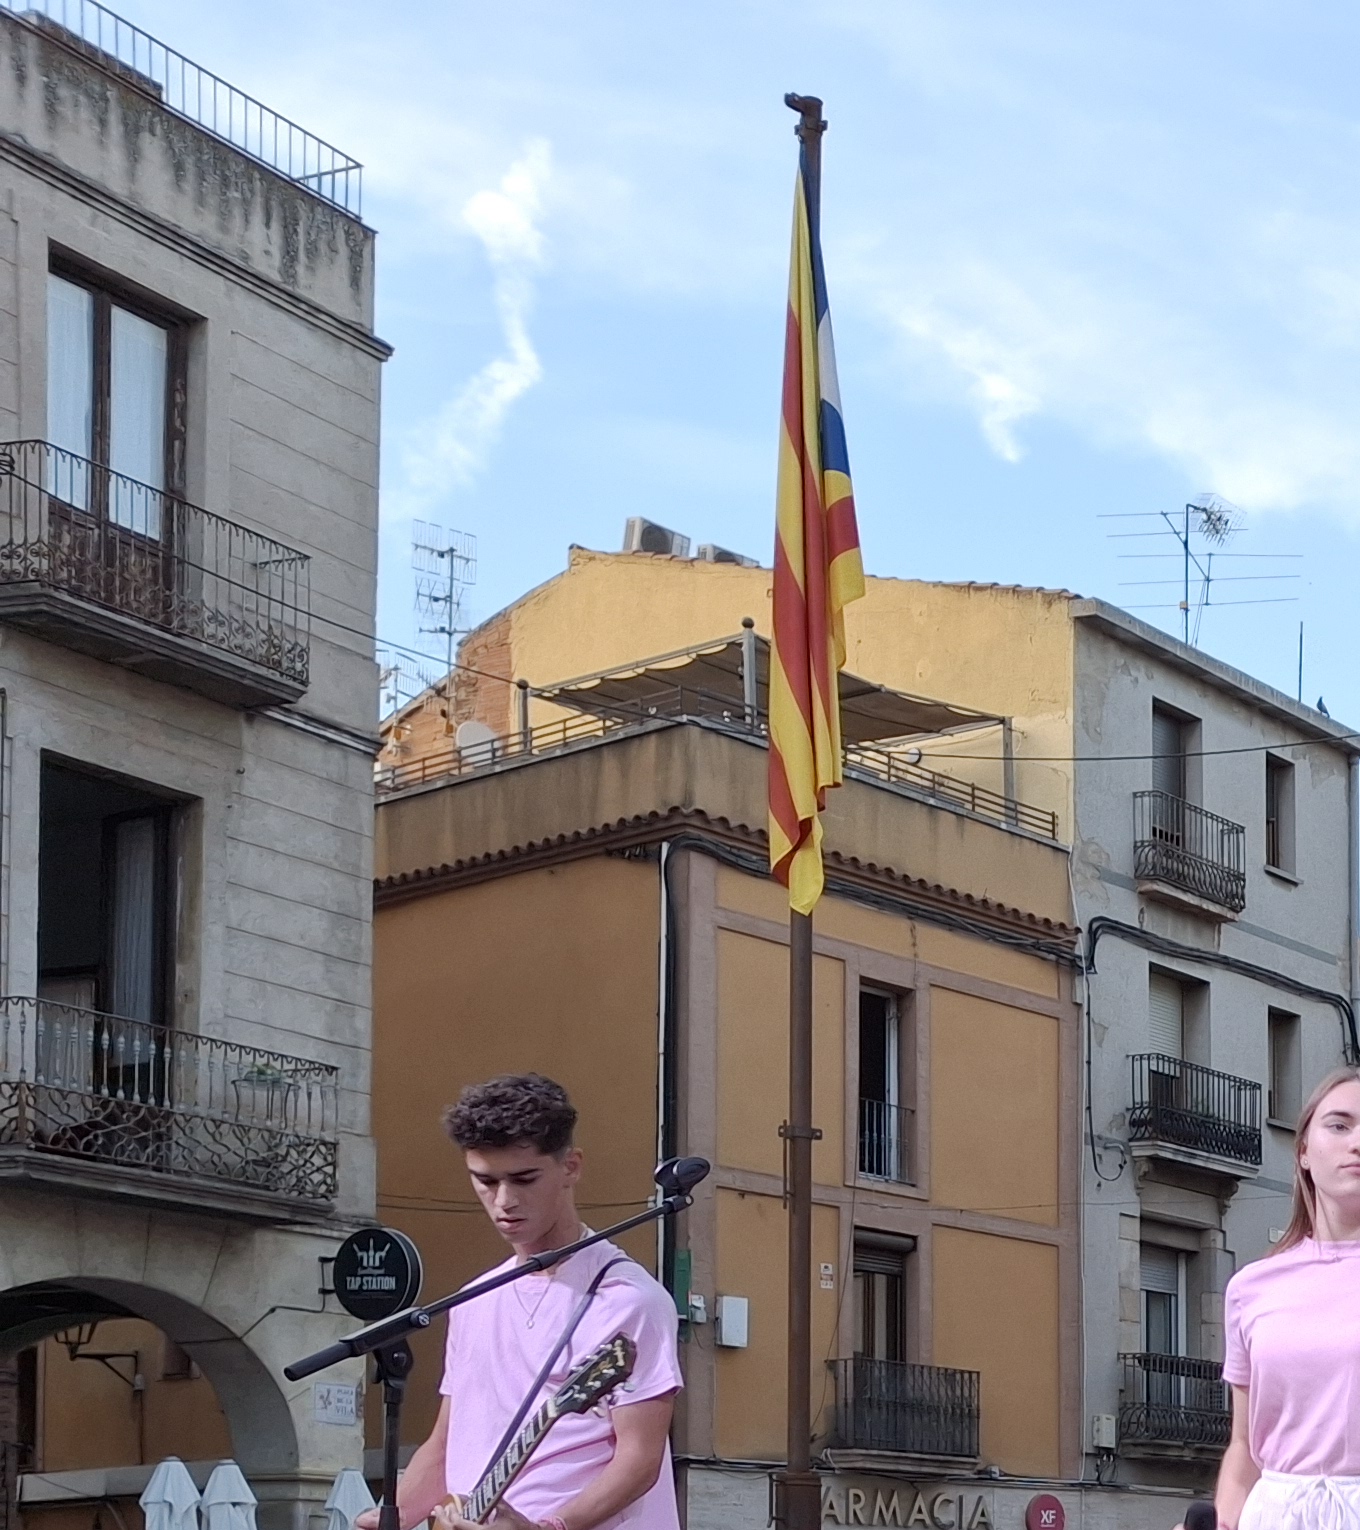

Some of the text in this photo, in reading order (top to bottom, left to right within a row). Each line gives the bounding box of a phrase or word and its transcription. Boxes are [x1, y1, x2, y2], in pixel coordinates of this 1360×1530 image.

[346, 1276, 396, 1291] TAP STATION
[1040, 1510, 1057, 1524] XF
